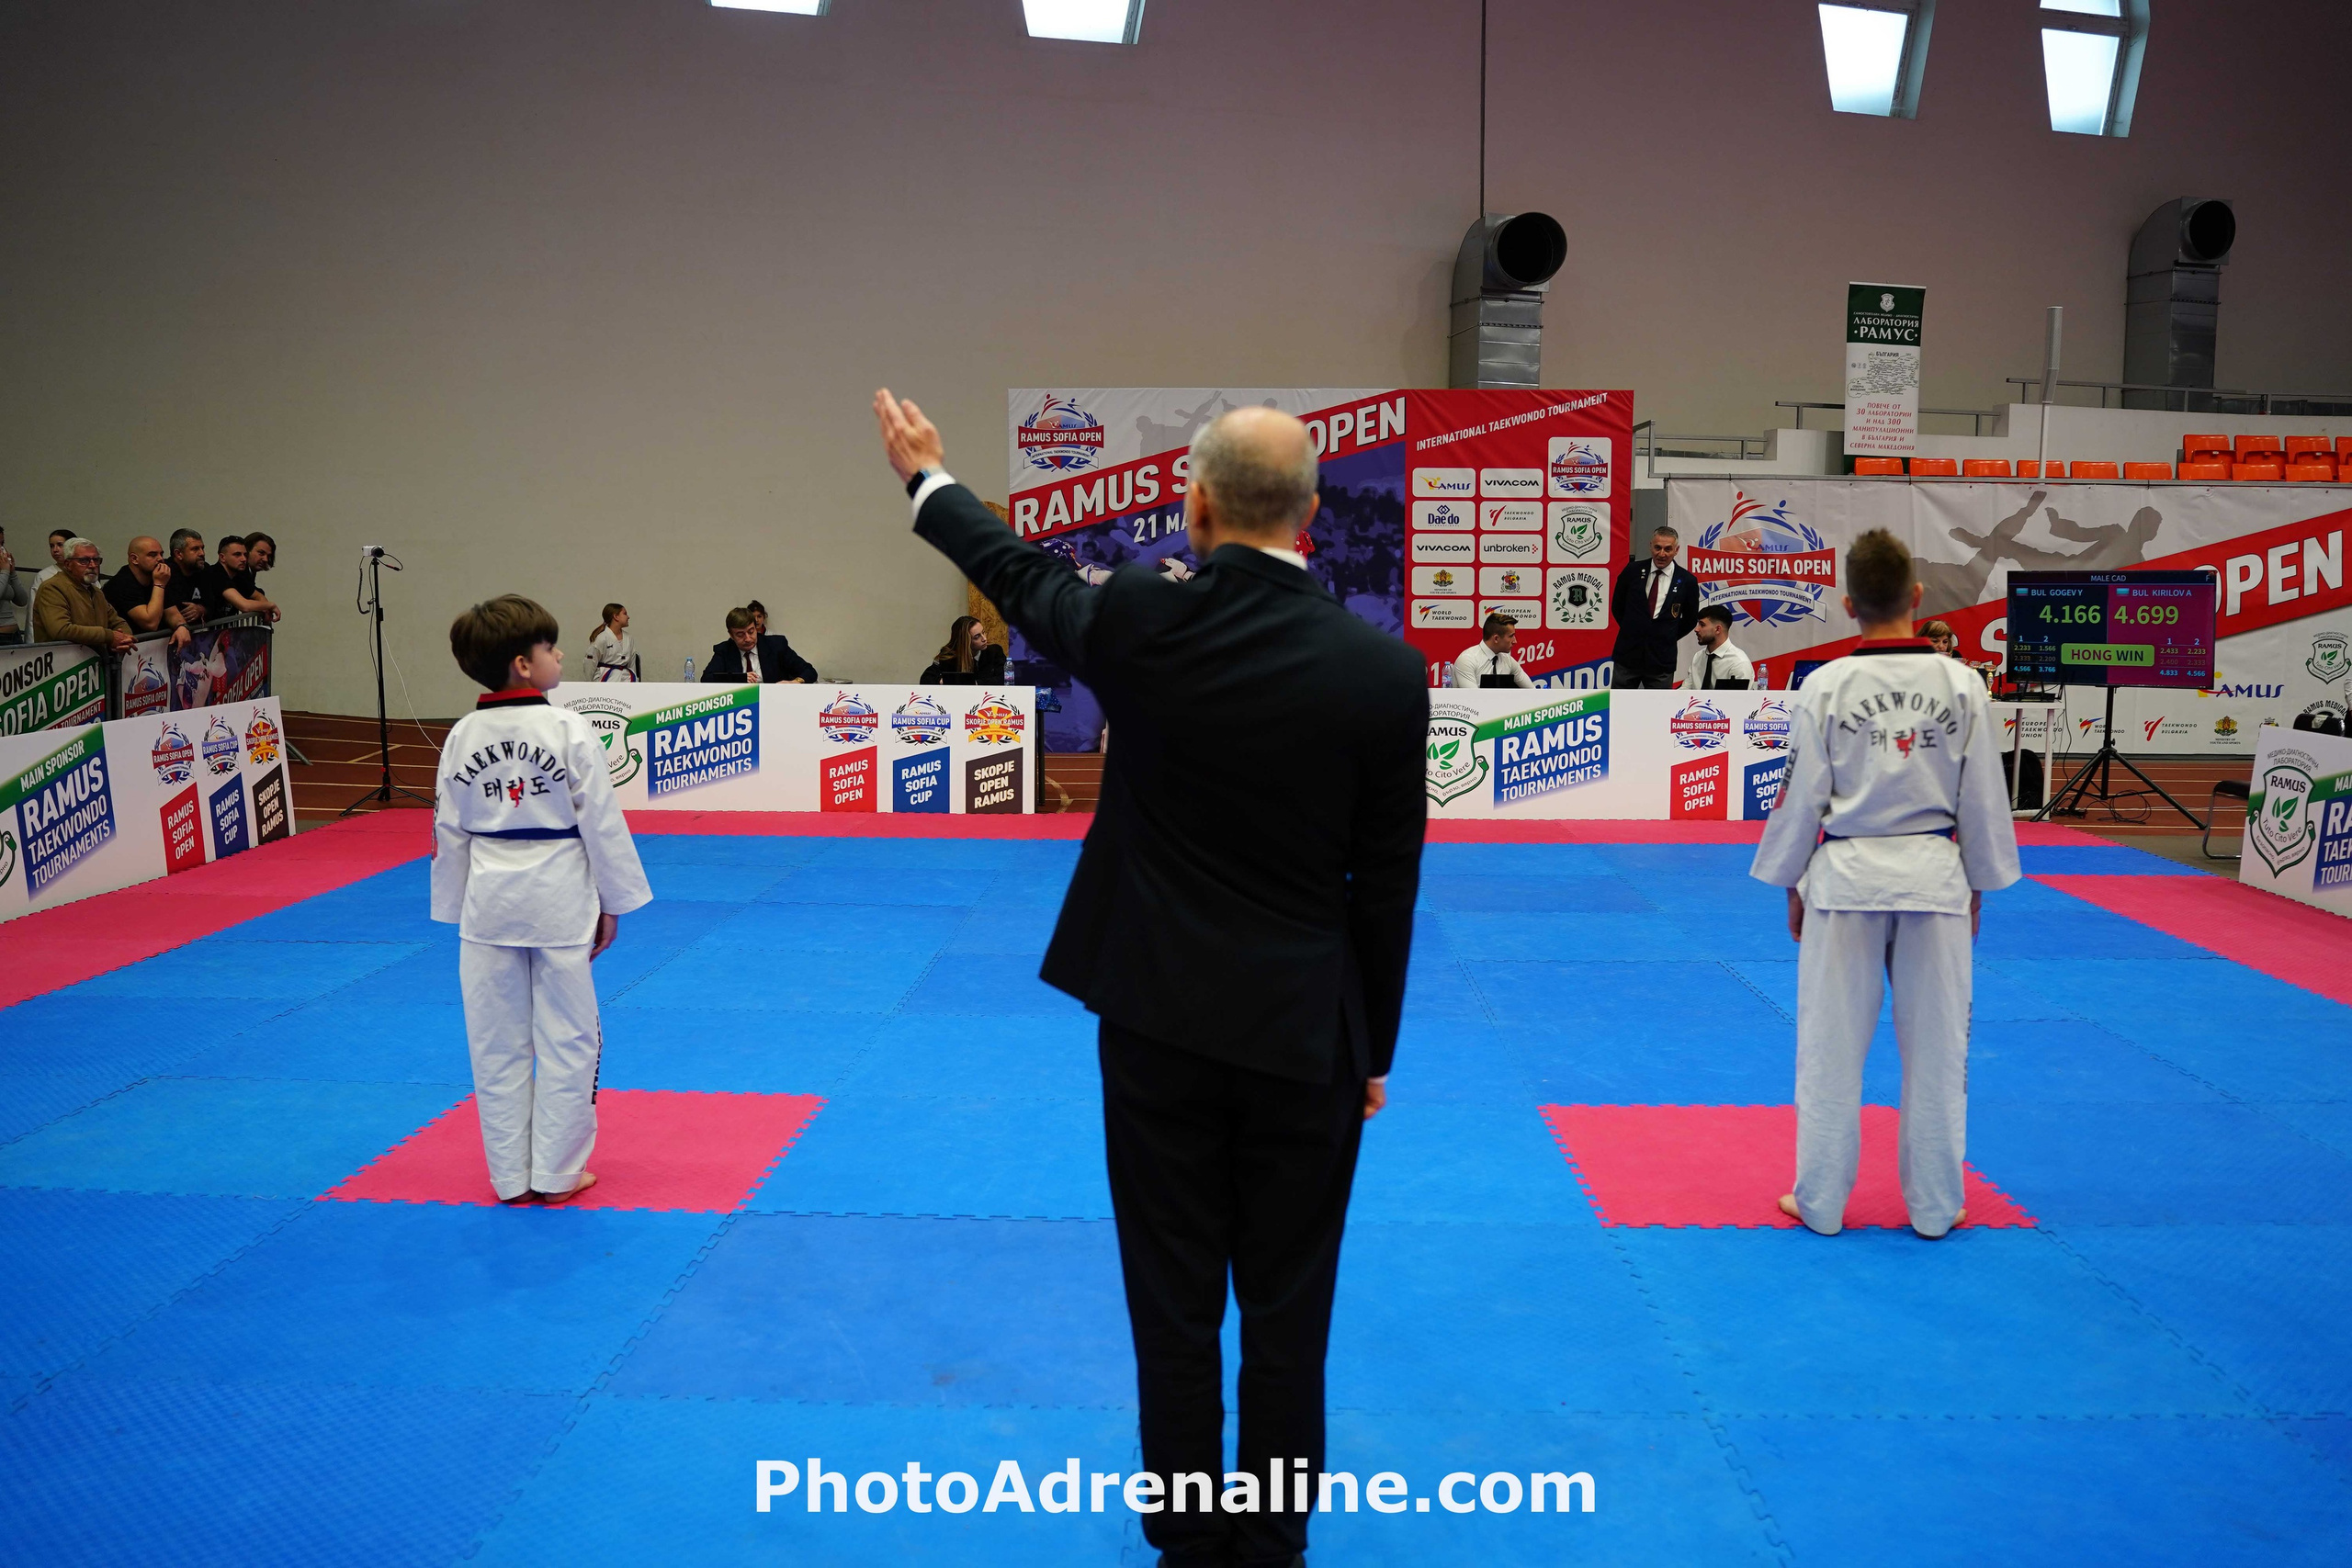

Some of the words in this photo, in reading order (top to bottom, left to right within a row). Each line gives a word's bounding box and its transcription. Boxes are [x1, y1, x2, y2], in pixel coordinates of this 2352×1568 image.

[1853, 317, 1918, 327] ЛАБОРАТОРИЯ
[1416, 424, 1487, 451] INTERNATIONAL
[1488, 409, 1545, 434] TAEKWONDO
[1547, 392, 1609, 417] TOURNAMENT
[1021, 432, 1051, 442] RAMUS
[1053, 432, 1078, 442] SOFIA
[1080, 432, 1102, 442] OPEN
[1014, 464, 1160, 537] RAMUS
[1133, 514, 1157, 544] 21
[1483, 544, 1530, 552] unbroken
[1691, 558, 1744, 574] RAMUS
[1747, 558, 1791, 574] SOFIA
[1793, 559, 1831, 575] OPEN
[1553, 573, 1576, 590] RAMUS
[1577, 572, 1603, 591] MEDICAL
[1710, 589, 1747, 604] INTERNATIONAL
[1780, 590, 1812, 604] TOURNAMENT
[2039, 605, 2101, 623] 4.166
[2114, 606, 2179, 625] 4.699
[1517, 639, 1555, 665] 2026
[2071, 649, 2112, 661] HONG
[2116, 649, 2143, 661] WIN
[0, 651, 53, 697] ONSOR
[244, 650, 264, 691] OPEN
[54, 661, 99, 713] OPEN
[125, 696, 141, 710] RAMUS
[142, 693, 155, 706] SOFIA
[155, 690, 167, 703] OPEN
[563, 696, 632, 710] МЕДИКО-ДИАГНОСТИЧНА
[573, 704, 623, 714] ЛАБОРАТОРИЯ
[656, 706, 683, 724] MAIN
[685, 694, 734, 716] SPONSOR
[893, 717, 916, 726] RAMUS
[917, 717, 935, 726] SOFIA
[937, 717, 950, 726] CUP
[987, 717, 1003, 726] OPEN
[1504, 713, 1532, 731] MAIN
[1534, 699, 1584, 723] SPONSOR
[1839, 692, 1958, 735] TAEKWONDO
[654, 708, 752, 758] RAMUS
[1428, 727, 1467, 736] AMUS
[1713, 722, 1729, 730] OPEN
[203, 744, 218, 755] RAMUS
[218, 742, 230, 752] SOFIA
[230, 739, 238, 750] CUP
[1502, 715, 1602, 765] RAMUS
[20, 765, 45, 793] MAIN
[46, 739, 85, 776] SPONSOR
[153, 753, 170, 764] RAMUS
[170, 751, 182, 761] SOFIA
[182, 749, 193, 759] OPEN
[454, 740, 566, 787] TAEKWONDO
[654, 738, 752, 777] TAEKWONDO
[1501, 744, 1602, 785] TAEKWONDO
[655, 757, 752, 795] TOURNAMENTS
[829, 759, 868, 779] RAMUS
[901, 760, 942, 780] RAMUS
[974, 761, 1015, 781] SKOPJE
[1435, 770, 1452, 778] Cito
[1453, 761, 1470, 776] Vere
[1679, 765, 1720, 784] RAMUS
[1753, 767, 1786, 785] RAMU
[258, 778, 280, 807] SKOPJE
[832, 774, 865, 792] SOFIA
[905, 775, 937, 793] SOFIA
[979, 776, 1009, 794] OPEN
[1501, 763, 1601, 802] TOURNAMENTS
[1682, 781, 1715, 798] SOFIA
[2270, 775, 2307, 793] RAMUS
[23, 756, 104, 839] RAMUS
[216, 789, 240, 818] RAMUS
[834, 788, 863, 805] OPEN
[910, 790, 933, 805] CUP
[974, 788, 1014, 809] RAMUS
[1684, 795, 1713, 811] OPEN
[167, 800, 194, 829] RAMUS
[263, 797, 279, 819] OPEN
[220, 807, 240, 831] SOFIA
[261, 809, 284, 838] RAMUS
[28, 794, 107, 865] TAEKWONDO
[172, 819, 194, 844] SOFIA
[224, 825, 238, 845] CUP
[32, 818, 110, 889] TOURNAMENTS
[175, 835, 195, 860] OPEN
